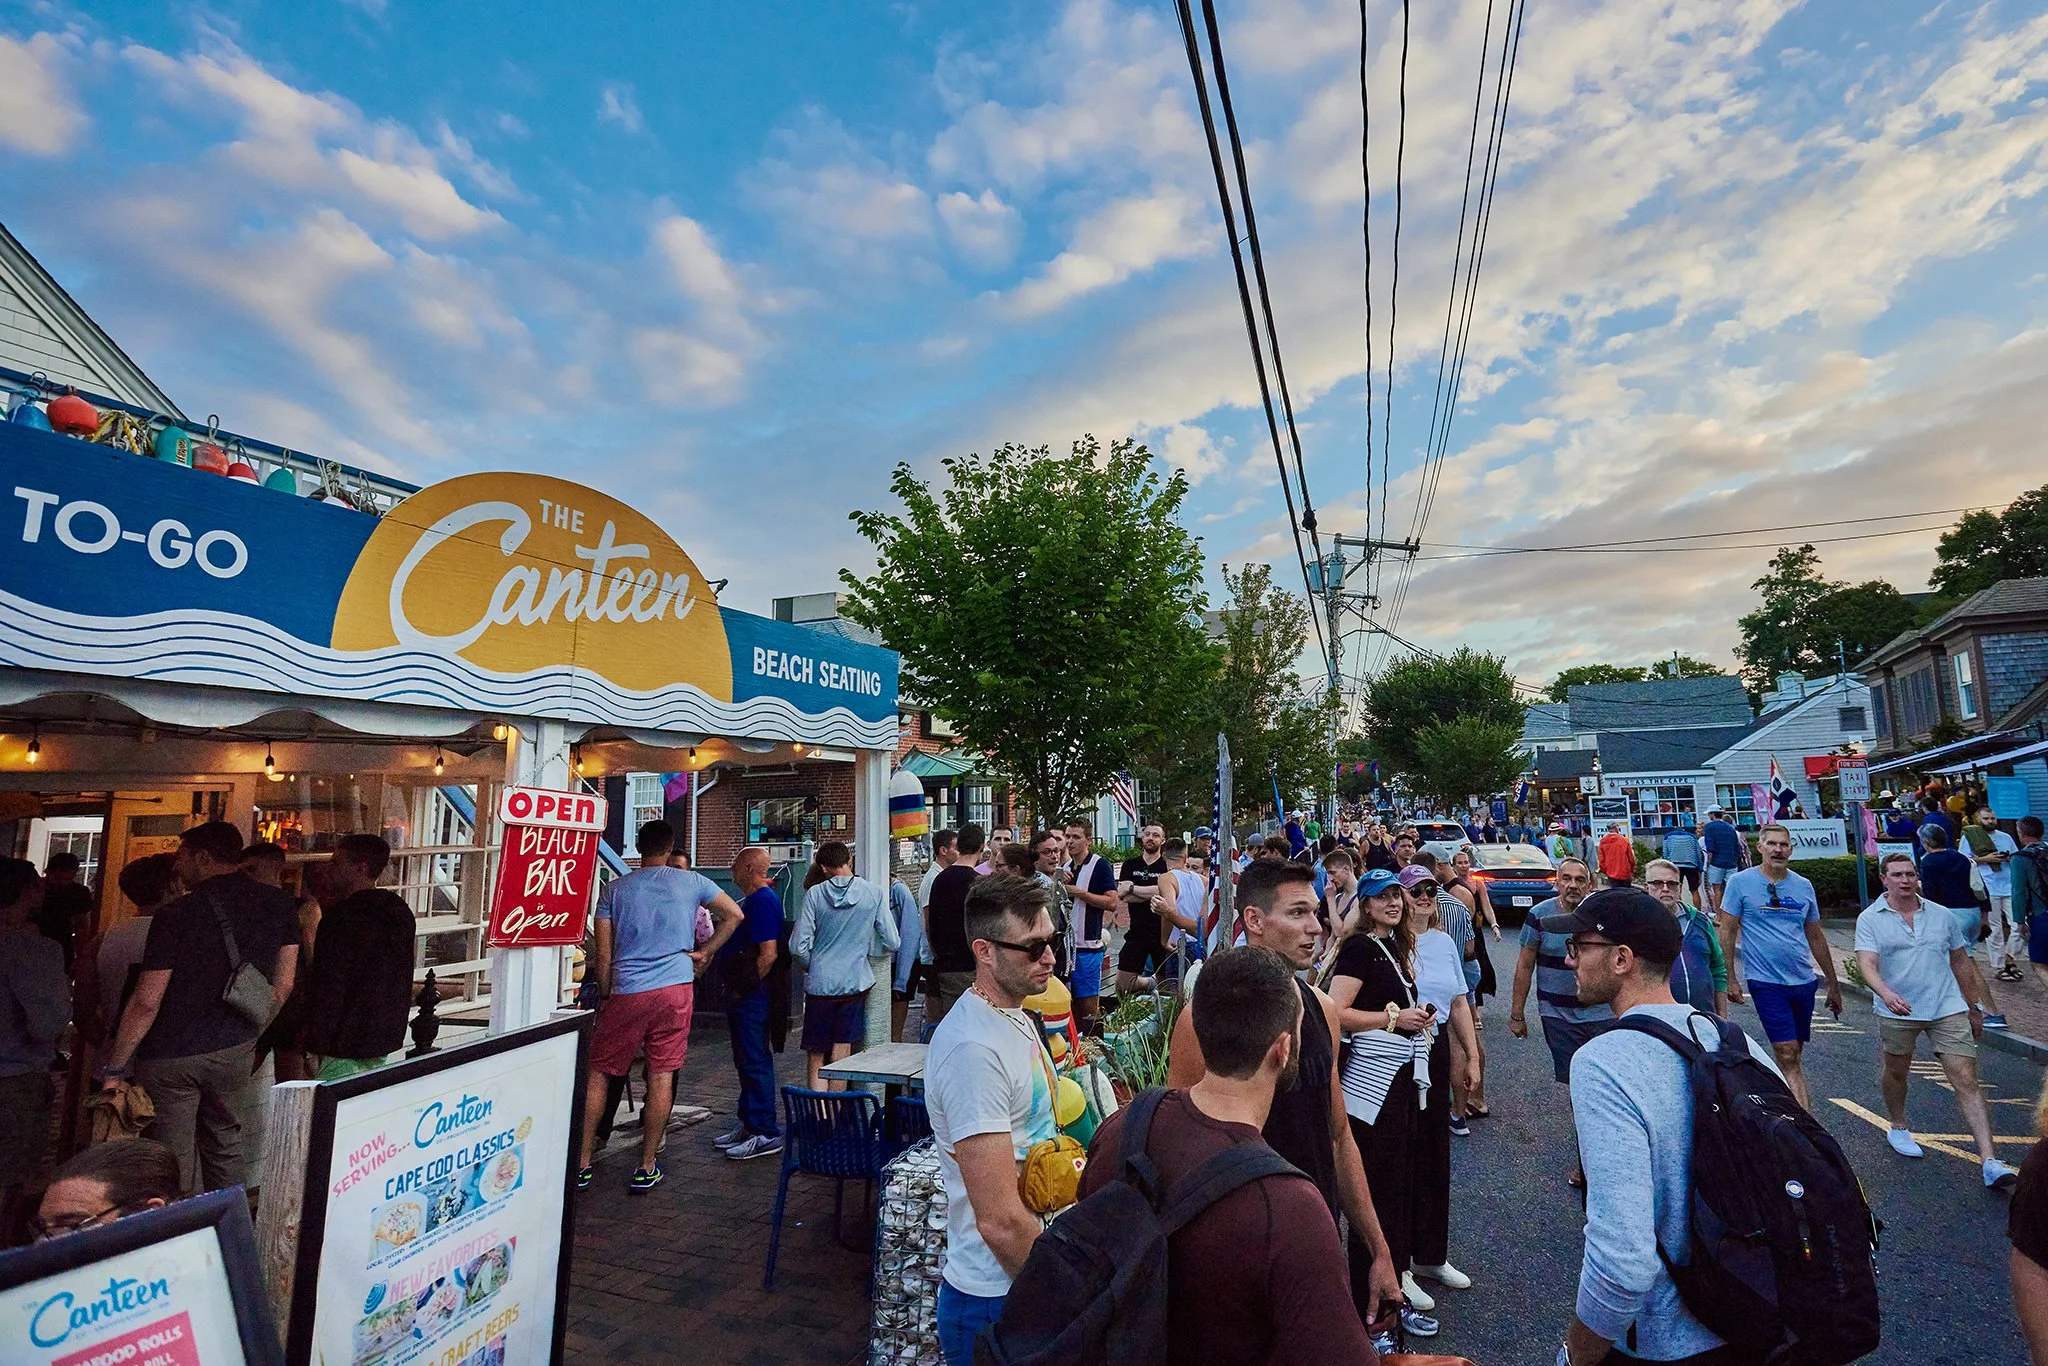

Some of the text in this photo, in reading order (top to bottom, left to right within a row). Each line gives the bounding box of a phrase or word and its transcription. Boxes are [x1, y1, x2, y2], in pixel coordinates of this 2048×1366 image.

[14, 487, 248, 578] TO-GO
[539, 498, 584, 534] THE
[389, 501, 695, 652] Canteen
[753, 646, 881, 697] BEACH SEATING
[1844, 772, 1863, 781] TAXI
[1844, 785, 1866, 794] STAND
[508, 791, 596, 824] OPEN
[519, 827, 587, 856] BEACH
[524, 858, 577, 897] BAR
[501, 906, 569, 944] Open
[537, 903, 544, 911] is
[414, 1093, 492, 1149] Canteen
[349, 1131, 386, 1167] NOW
[384, 1128, 515, 1200] CAPE COD CLASSICS
[332, 1142, 410, 1198] SERVING...
[389, 1228, 498, 1304] NEW FAVORITES
[29, 1277, 170, 1348] Canteen
[485, 1302, 520, 1341] BEERS
[137, 1325, 183, 1353] ROLLS
